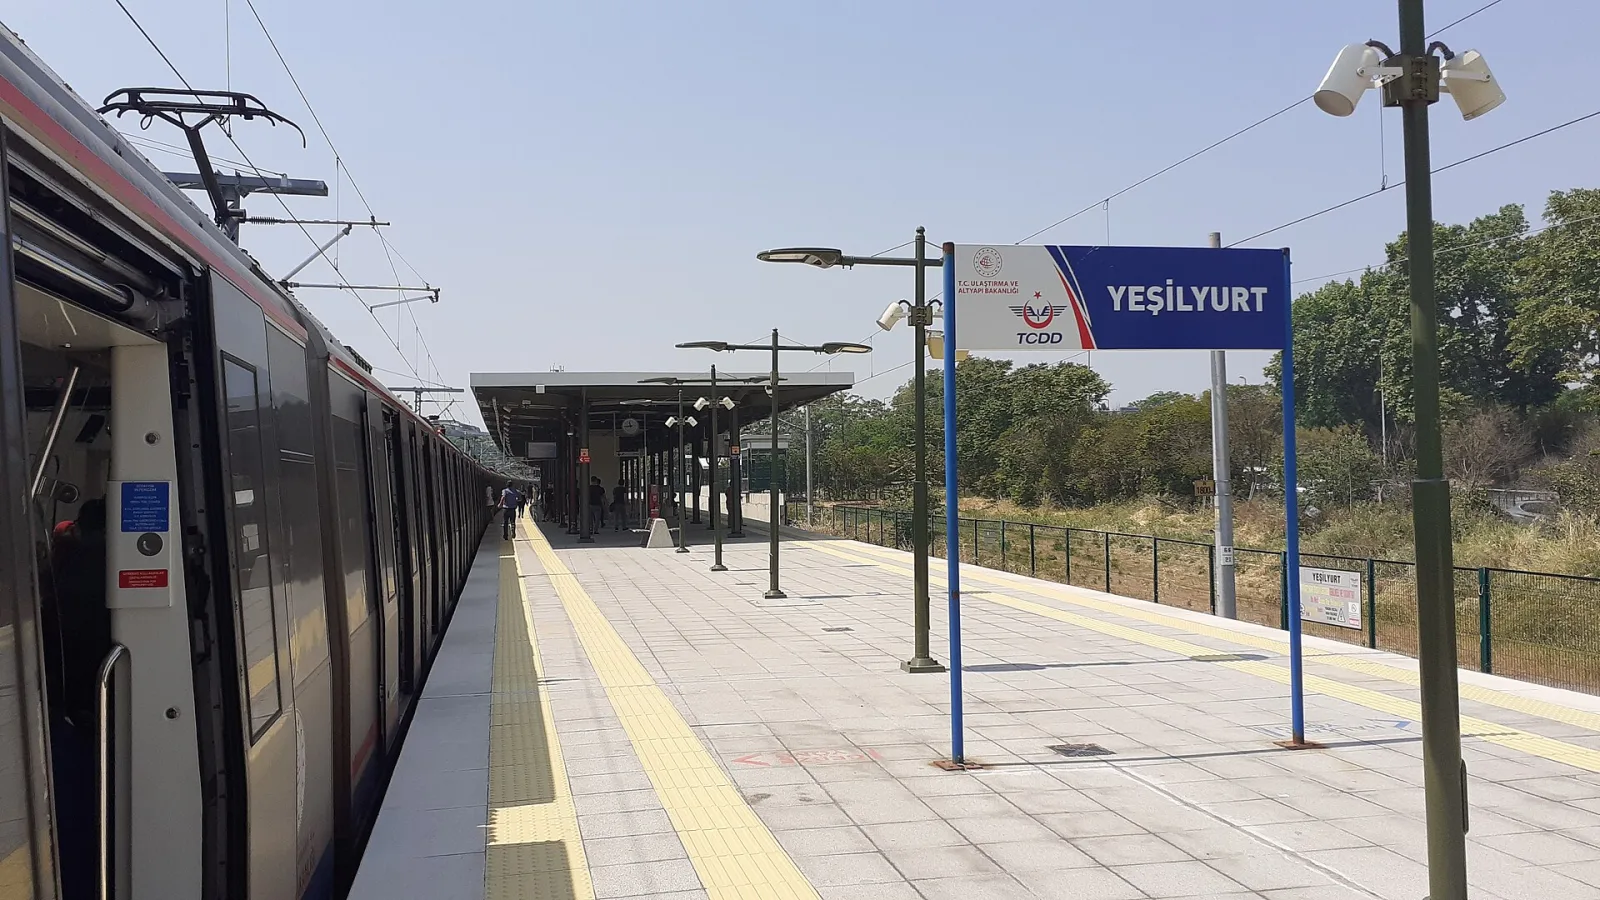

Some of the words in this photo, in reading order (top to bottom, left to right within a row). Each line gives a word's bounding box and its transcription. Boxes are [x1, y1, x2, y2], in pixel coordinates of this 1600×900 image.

[1106, 279, 1268, 316] YEŞİLYURT
[1016, 332, 1063, 345] TCDD
[1312, 571, 1341, 584] YEŞİLYURT
